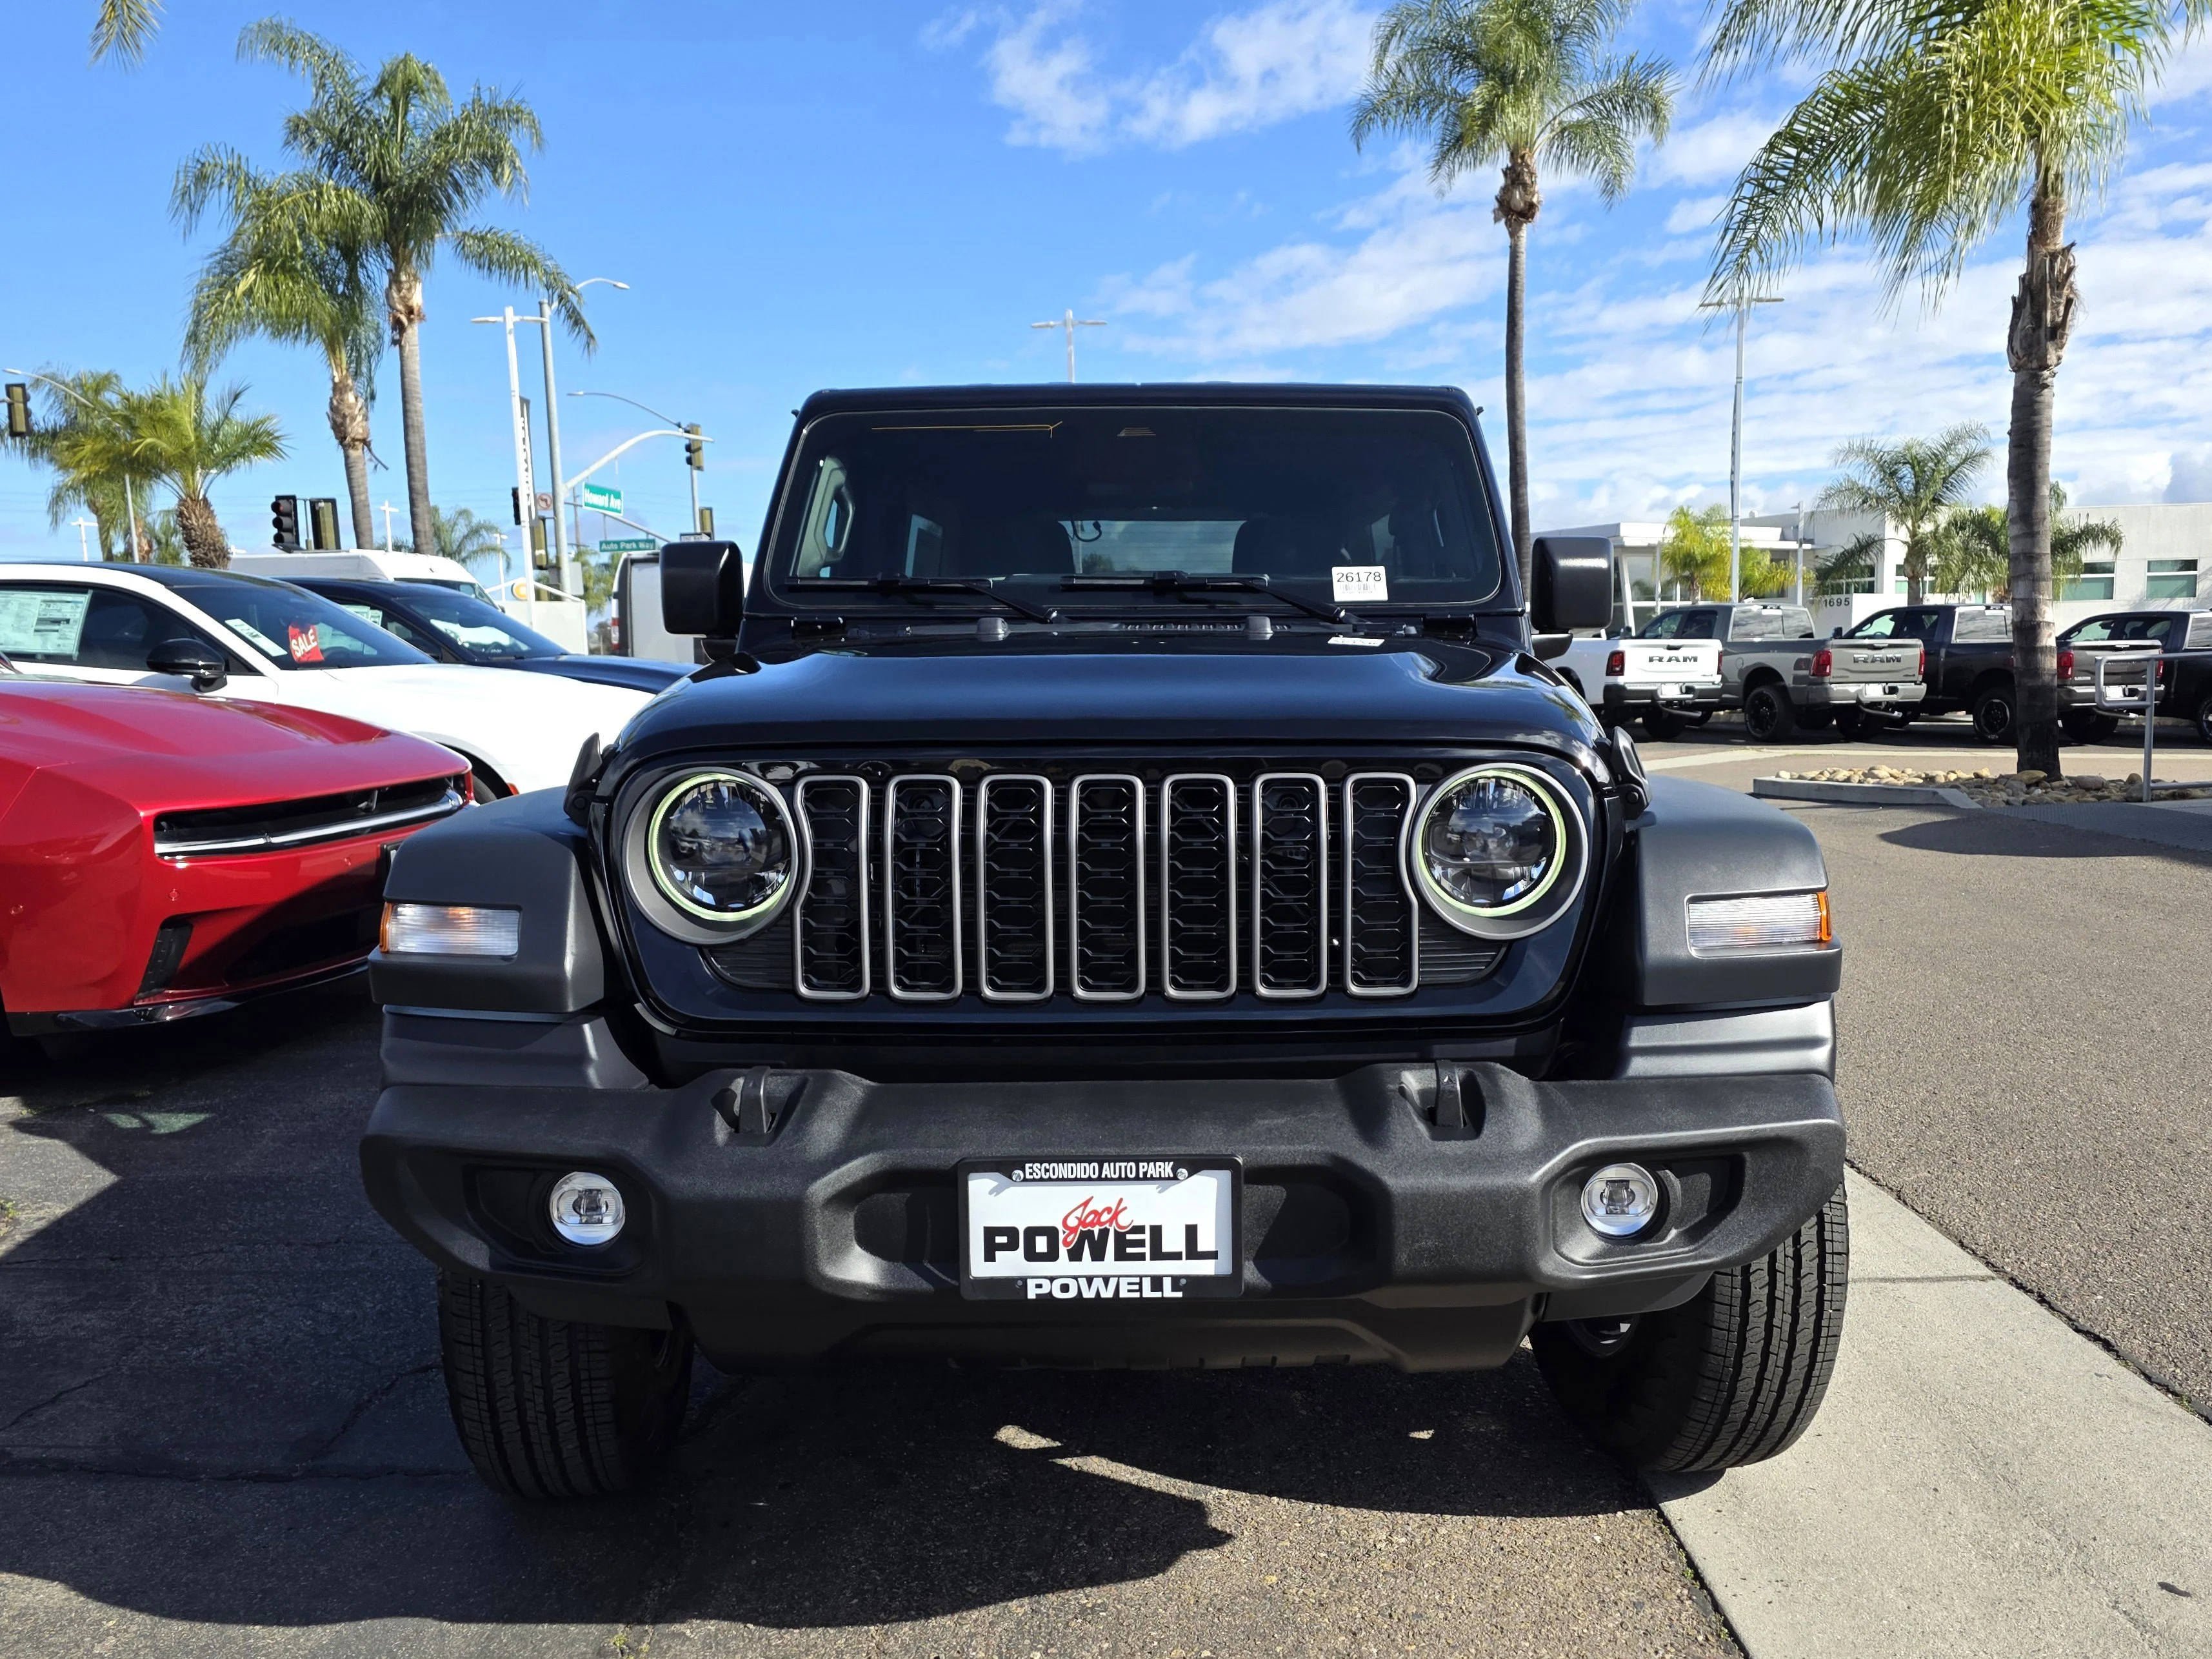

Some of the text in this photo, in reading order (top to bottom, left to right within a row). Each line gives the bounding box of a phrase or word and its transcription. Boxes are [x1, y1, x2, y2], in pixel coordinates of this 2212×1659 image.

[584, 488, 621, 510] Howard Ave
[639, 541, 654, 550] Way
[1337, 572, 1381, 582] 26178
[1824, 597, 1850, 607] 1695
[291, 628, 317, 658] SALE
[1853, 654, 1902, 663] RAM
[1025, 1161, 1173, 1180] ESCONDIDO AUTO PARK
[1062, 1196, 1134, 1249] Jack
[983, 1224, 1218, 1262] POWELL
[1027, 1277, 1182, 1299] POWELL
